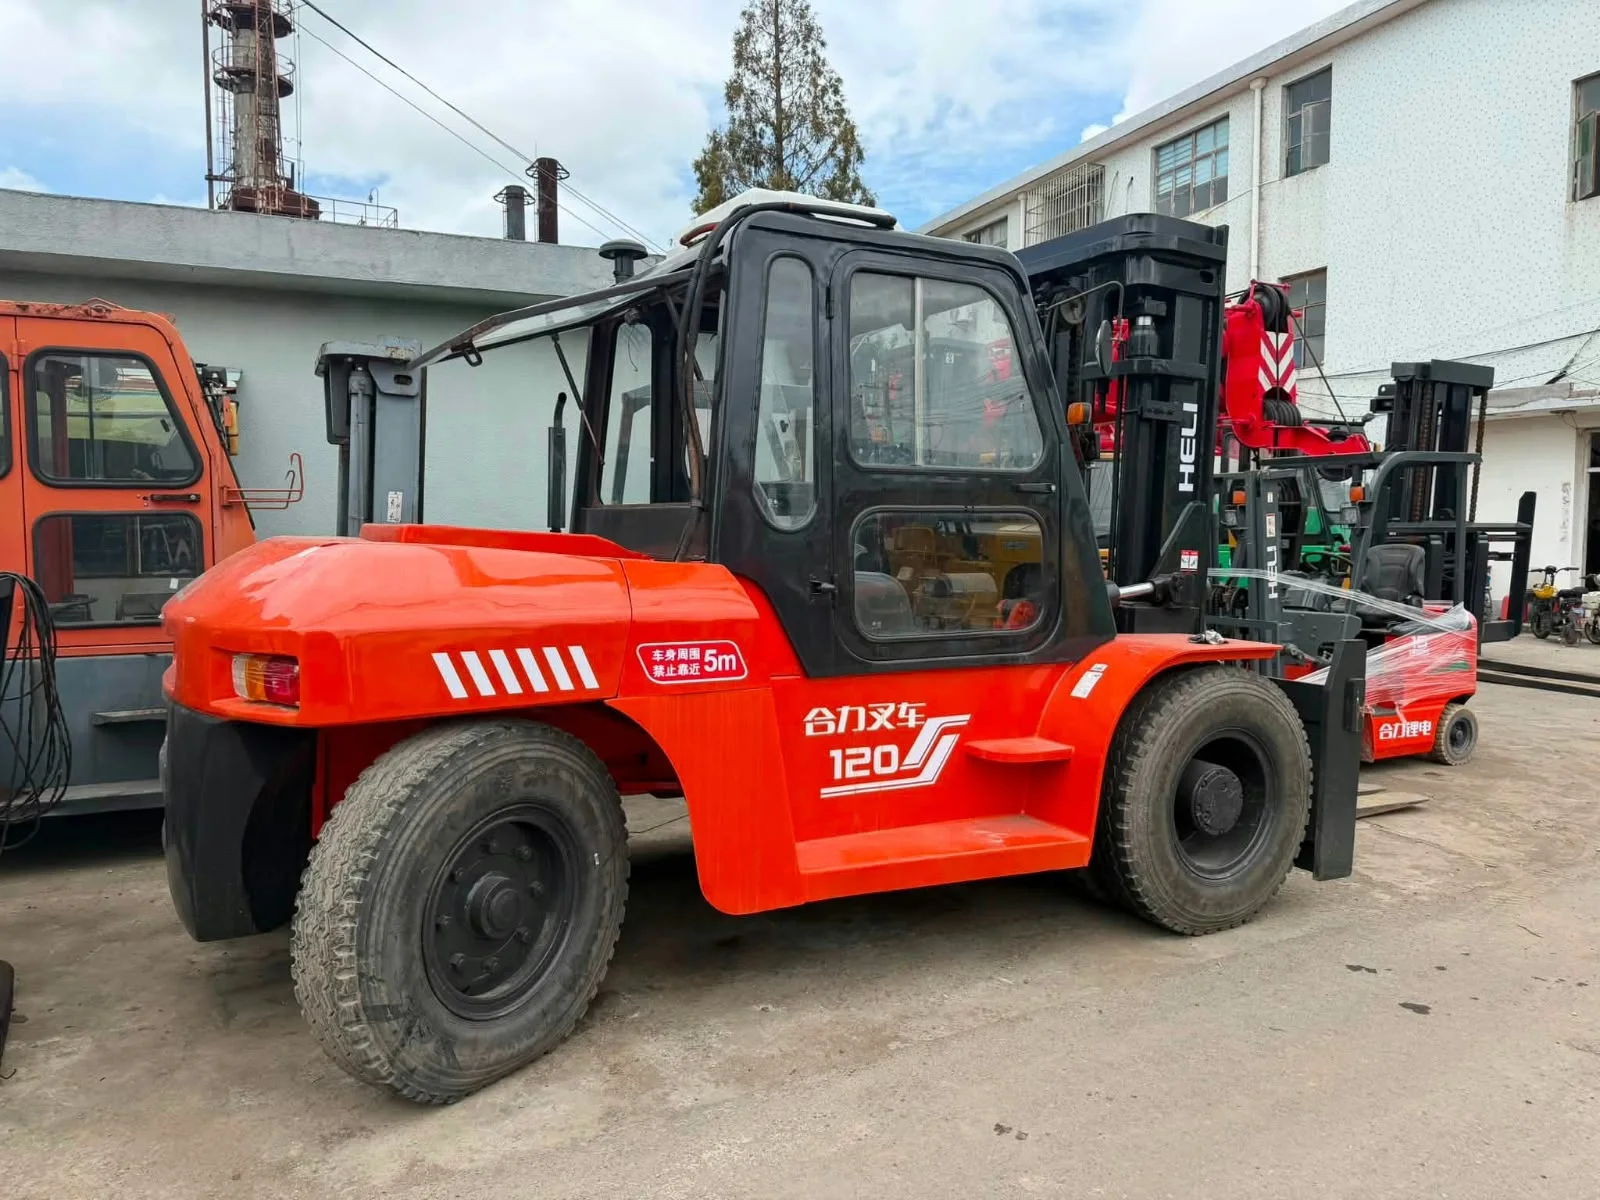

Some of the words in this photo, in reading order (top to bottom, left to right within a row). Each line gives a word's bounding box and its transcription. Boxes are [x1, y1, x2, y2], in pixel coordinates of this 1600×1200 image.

[1178, 402, 1198, 492] HELI
[1266, 545, 1278, 599] HELI
[652, 648, 701, 662] 车身周围
[703, 649, 737, 672] 5m
[652, 663, 701, 678] 禁止靠近
[803, 702, 927, 736] 合力叉车
[1379, 720, 1432, 739] 合力锂电
[829, 744, 899, 780] 120
